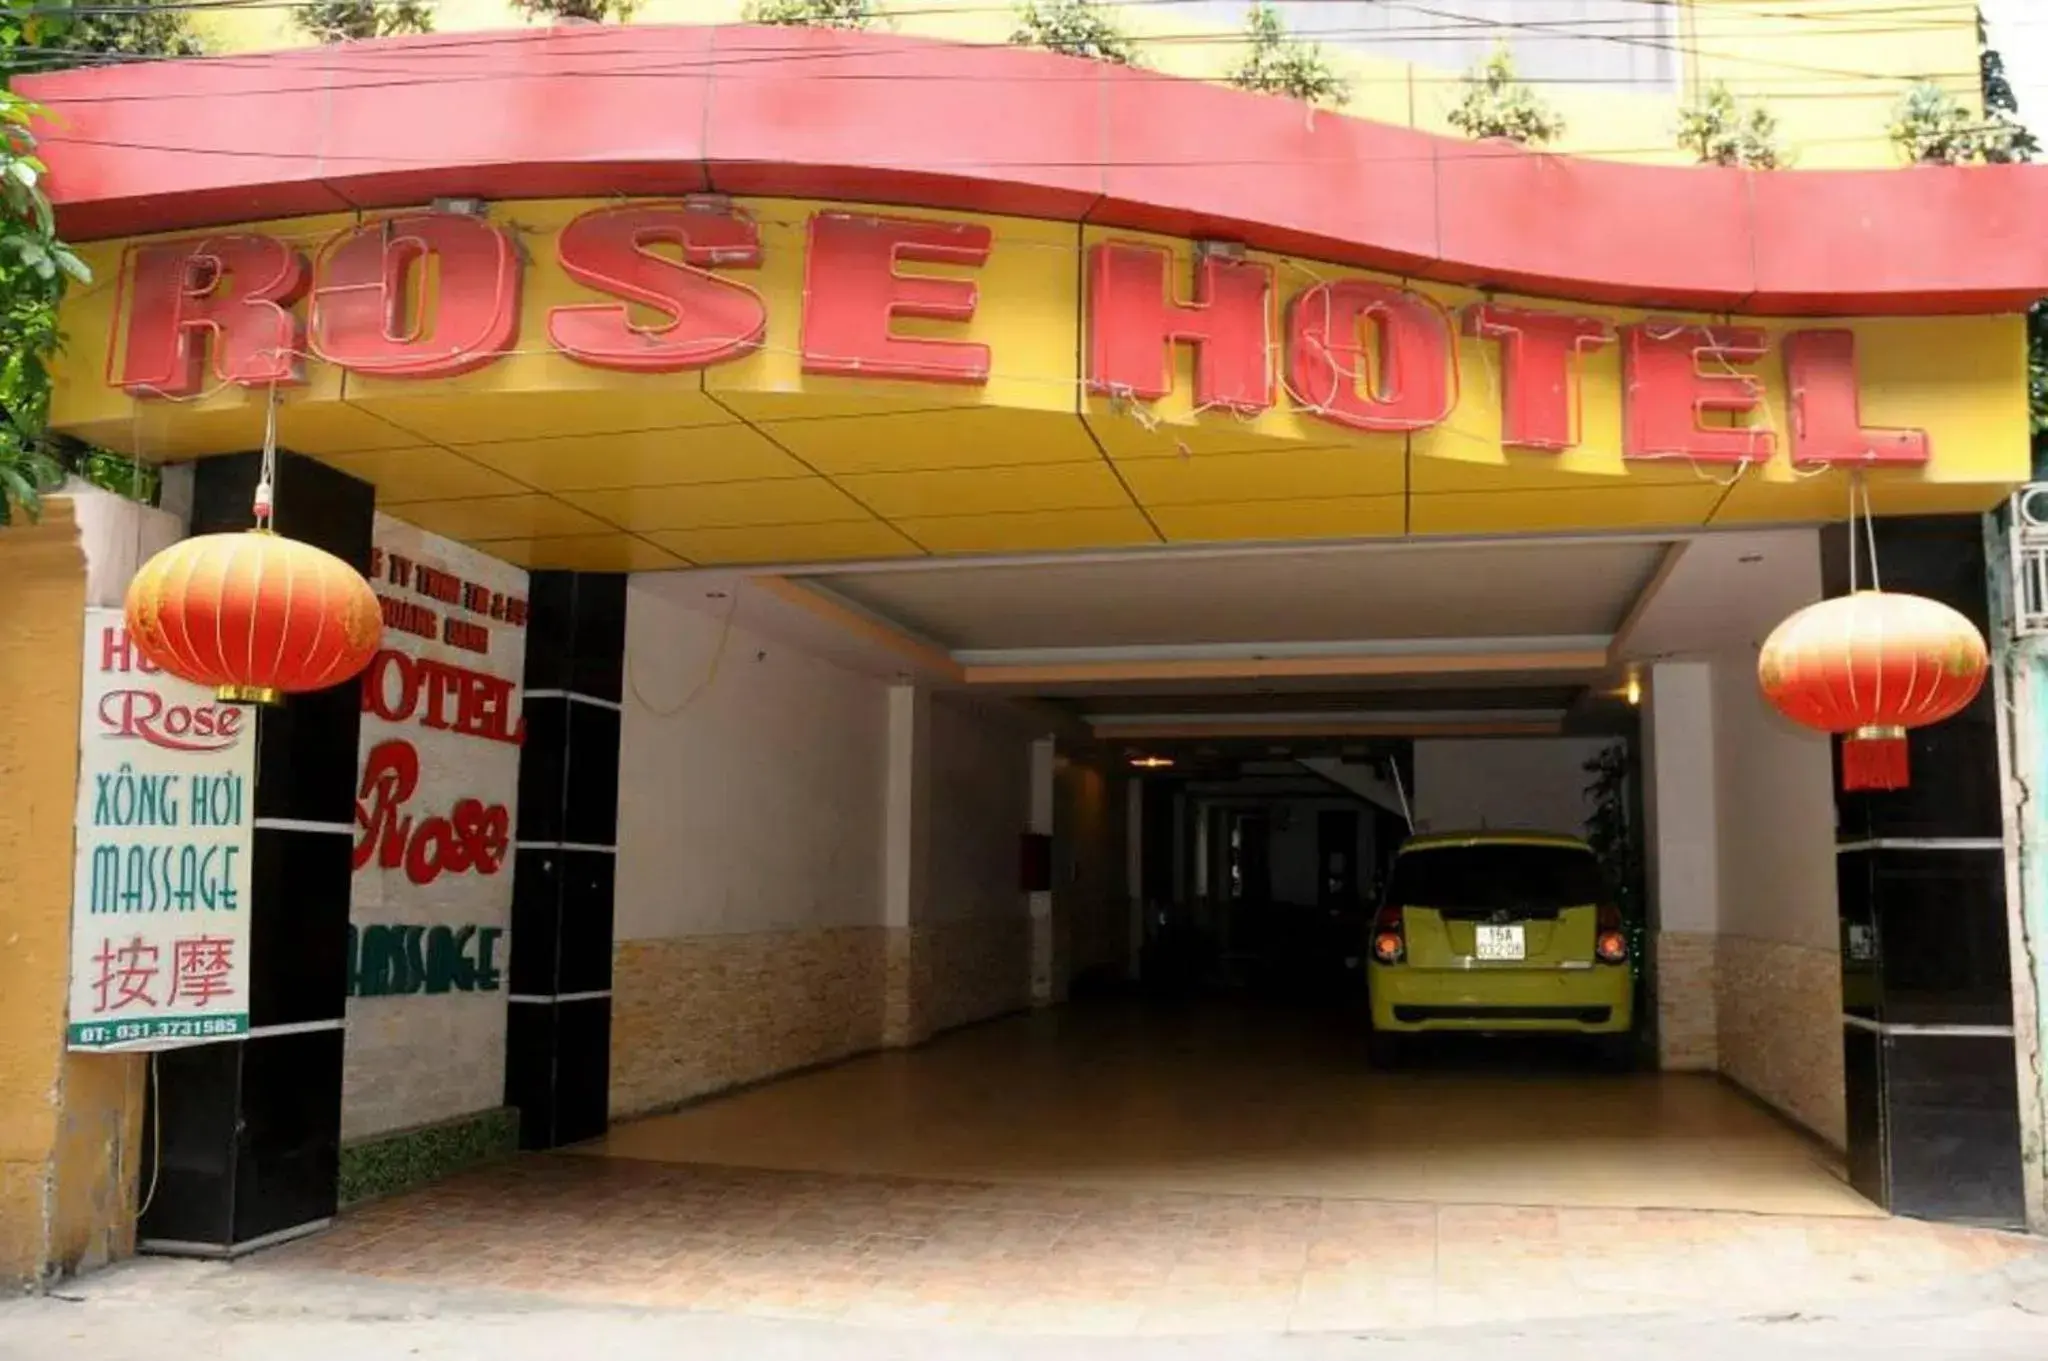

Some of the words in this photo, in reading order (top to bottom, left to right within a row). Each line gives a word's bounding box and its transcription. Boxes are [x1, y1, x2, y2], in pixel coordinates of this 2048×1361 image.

[107, 200, 994, 398] ROSE
[1086, 238, 1930, 468] HOTEL
[98, 689, 243, 754] Rose
[94, 763, 178, 826] XÔNG
[352, 737, 509, 886] Rose
[91, 844, 240, 914] MASSAGE
[91, 934, 236, 1013] 按摩
